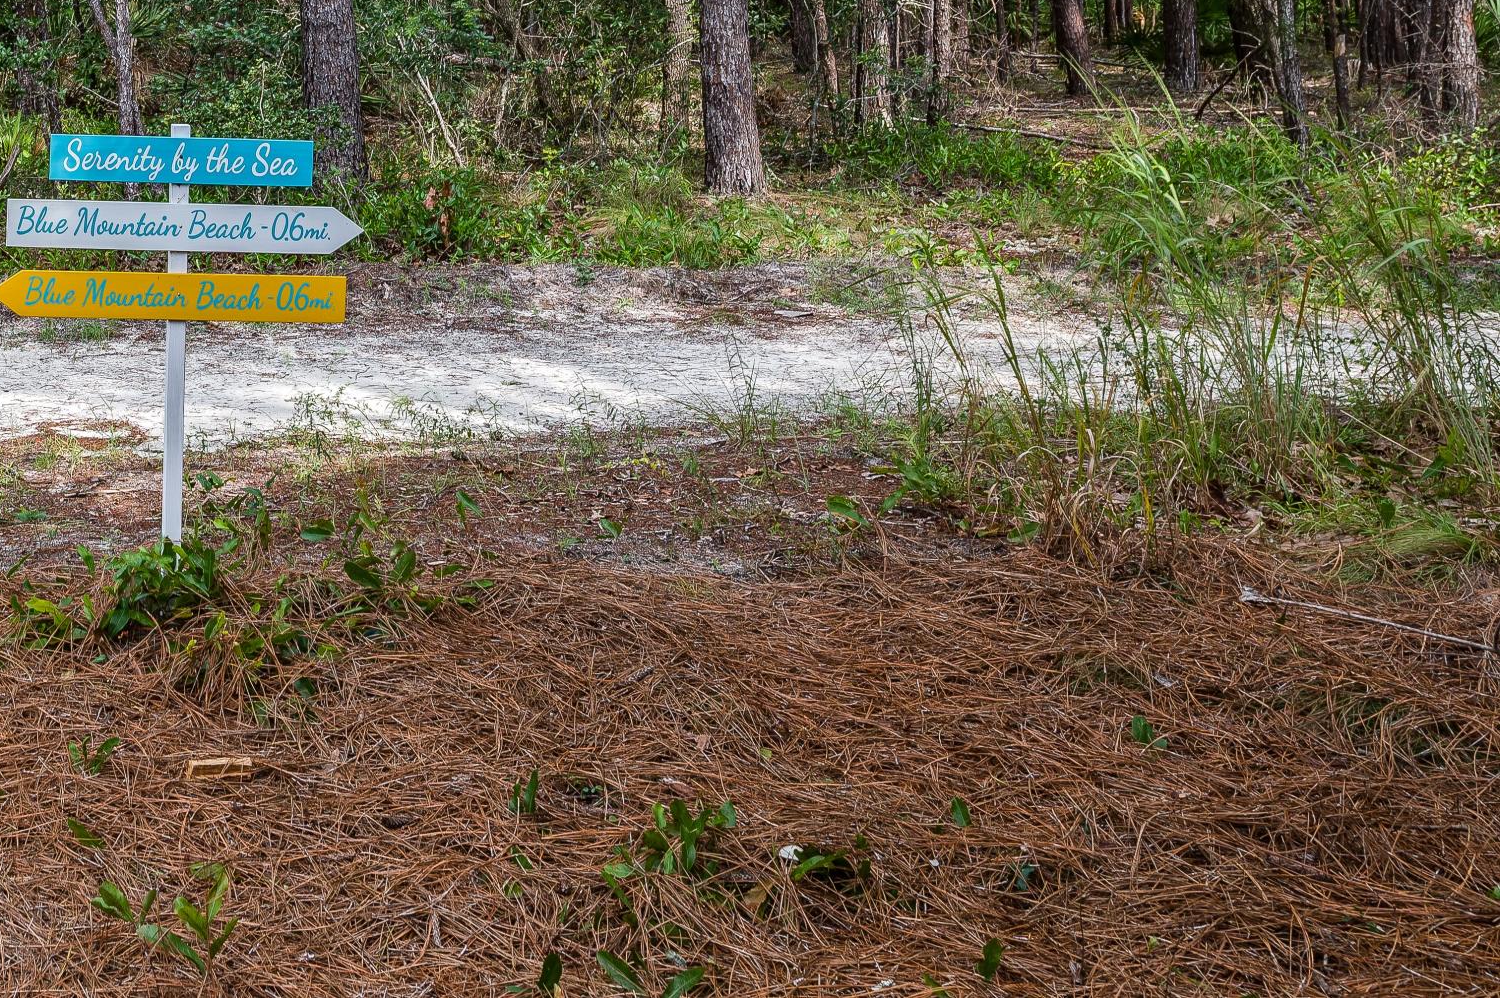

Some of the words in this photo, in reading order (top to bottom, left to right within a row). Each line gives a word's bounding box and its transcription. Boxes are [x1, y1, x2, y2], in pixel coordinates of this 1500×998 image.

[63, 138, 166, 180] Serenity
[170, 142, 200, 182] by
[205, 143, 246, 174] the
[251, 142, 299, 177] Sea
[16, 205, 69, 235] Blue
[73, 206, 182, 237] Mountain
[188, 209, 256, 240] Beach
[24, 275, 76, 306] Blue
[81, 277, 188, 308] Mountain
[196, 280, 263, 310] Beach
